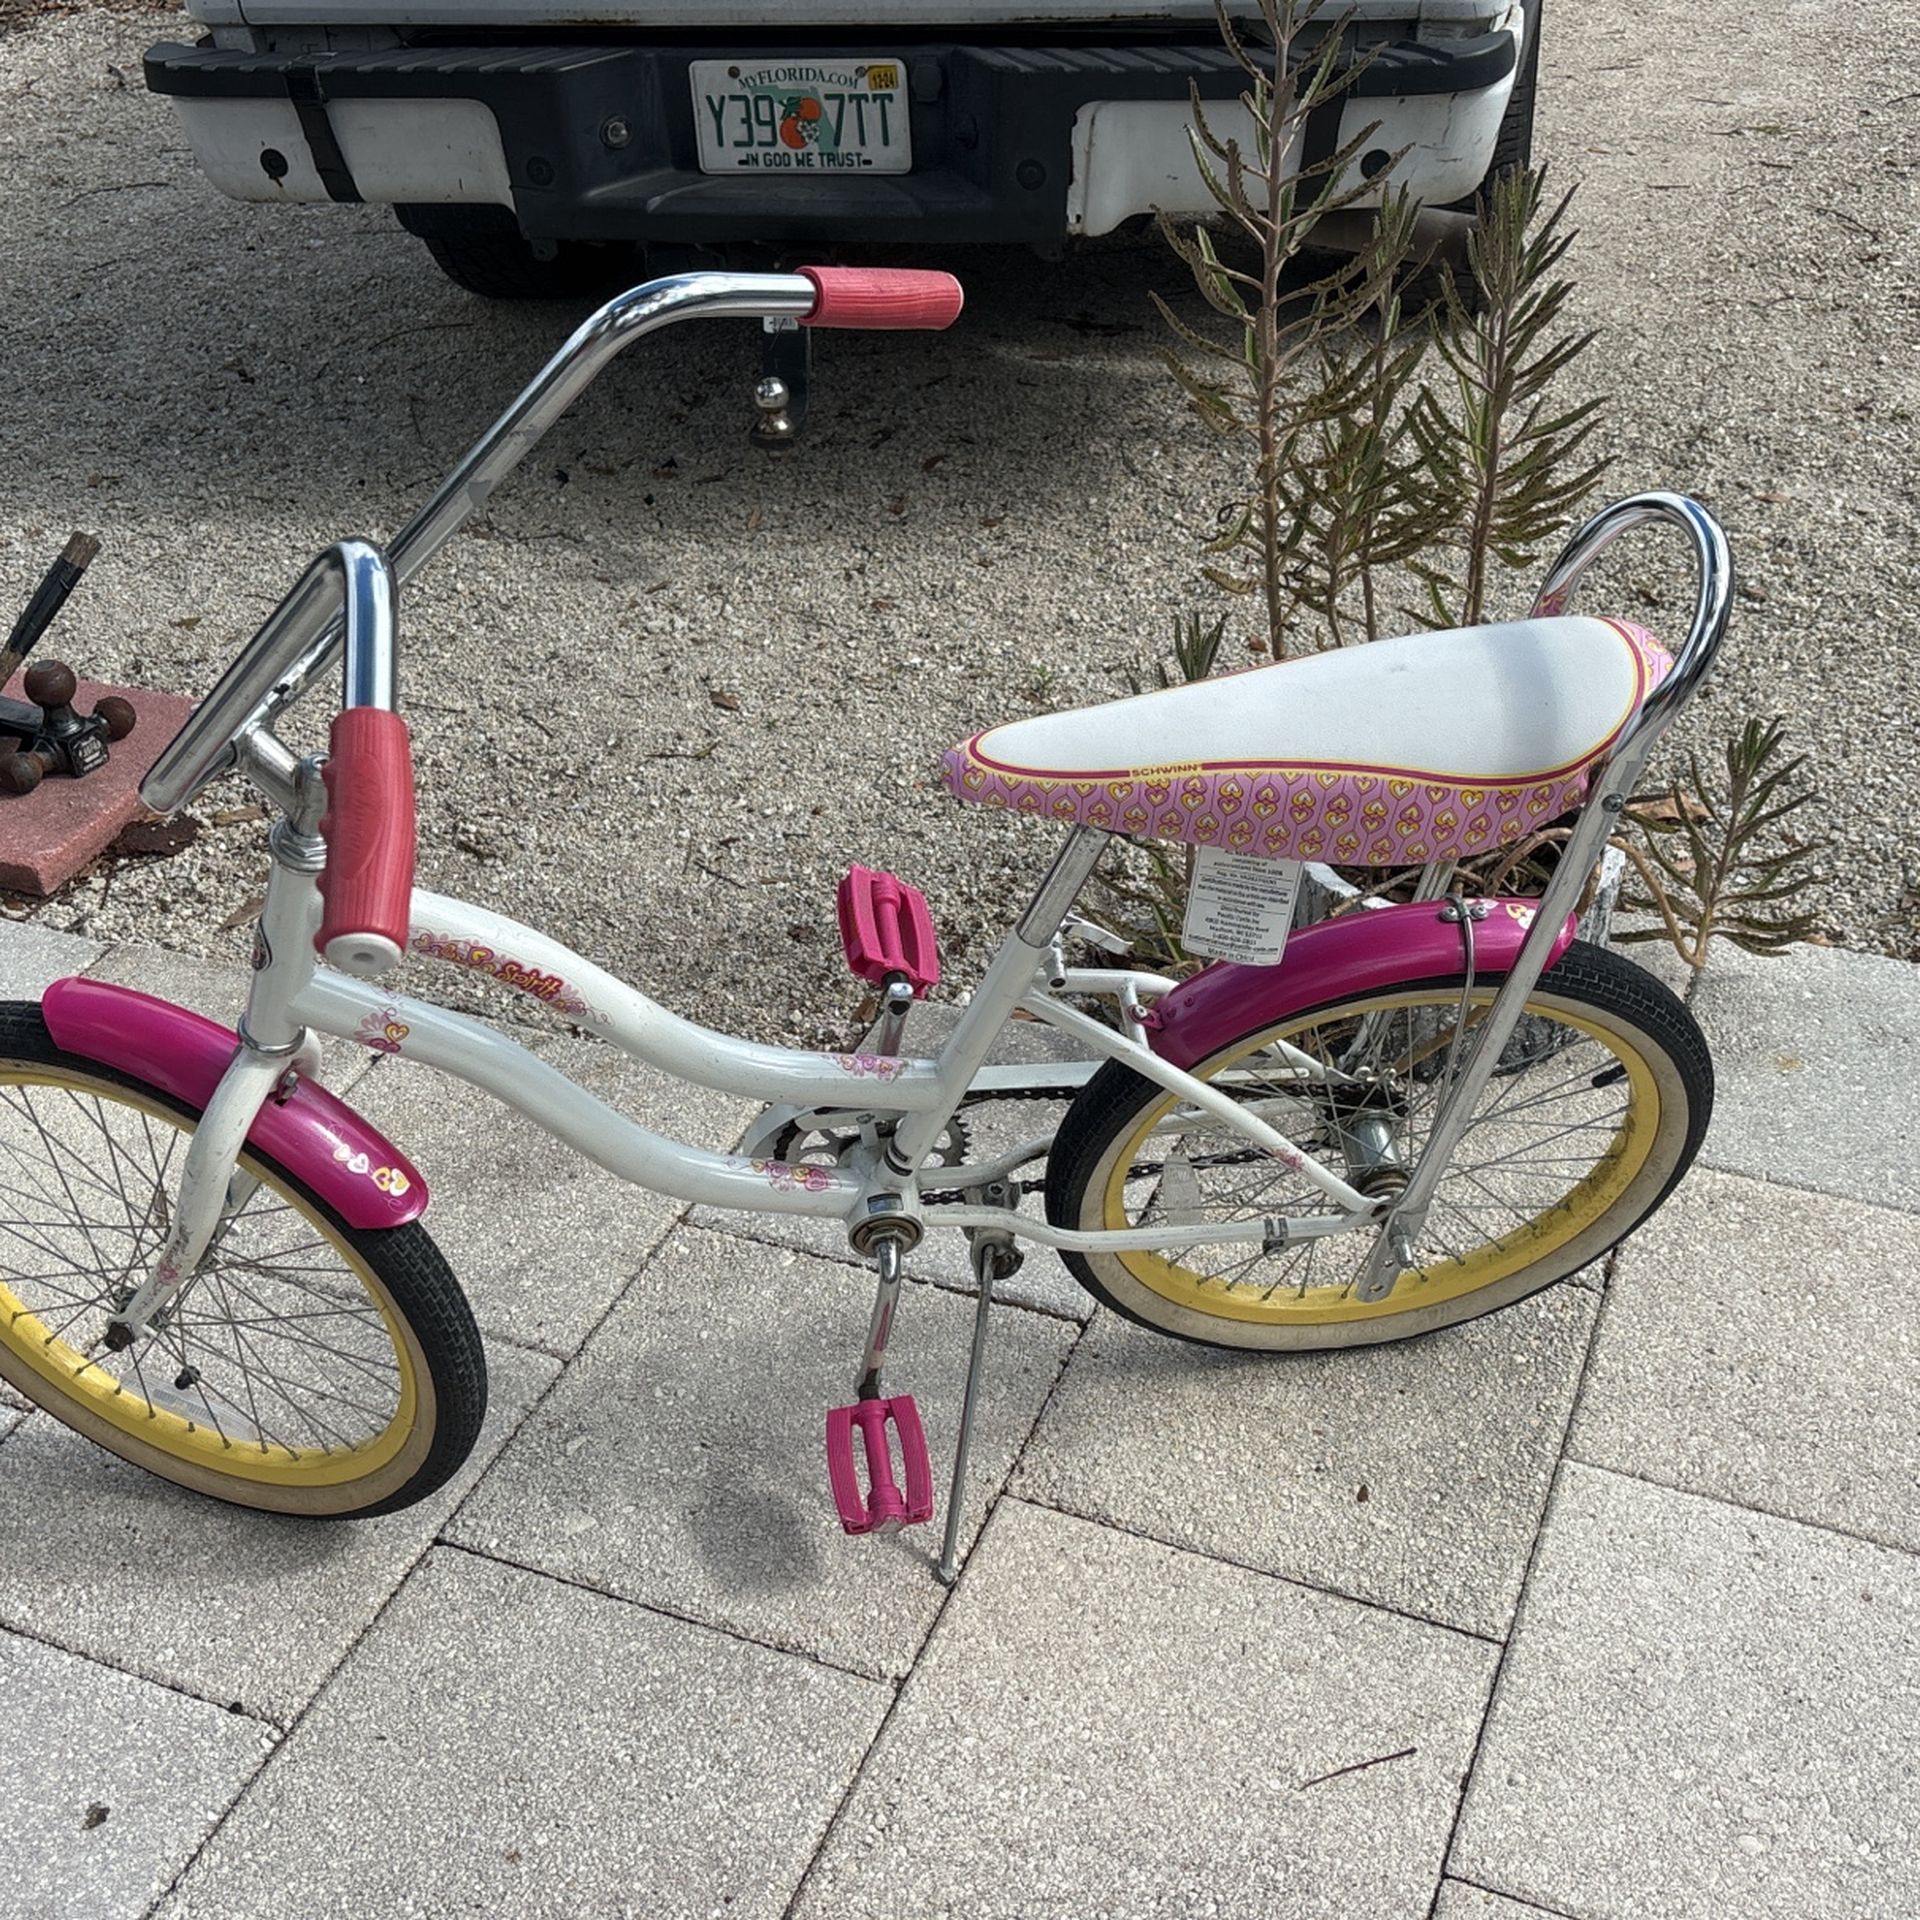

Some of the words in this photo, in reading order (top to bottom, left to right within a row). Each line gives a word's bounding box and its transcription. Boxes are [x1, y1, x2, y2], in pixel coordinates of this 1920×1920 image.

[738, 67, 859, 90] MYFLORIDA.COM
[705, 93, 778, 148] Y39
[823, 93, 894, 147] 7TT
[746, 152, 760, 167] IN
[763, 152, 792, 168] GOD
[798, 152, 815, 168] WE
[819, 152, 863, 168] TRUST
[1131, 763, 1198, 777] SCHWINN
[1207, 947, 1227, 956] Made
[1234, 952, 1254, 961] China
[496, 961, 564, 1000] Spirit
